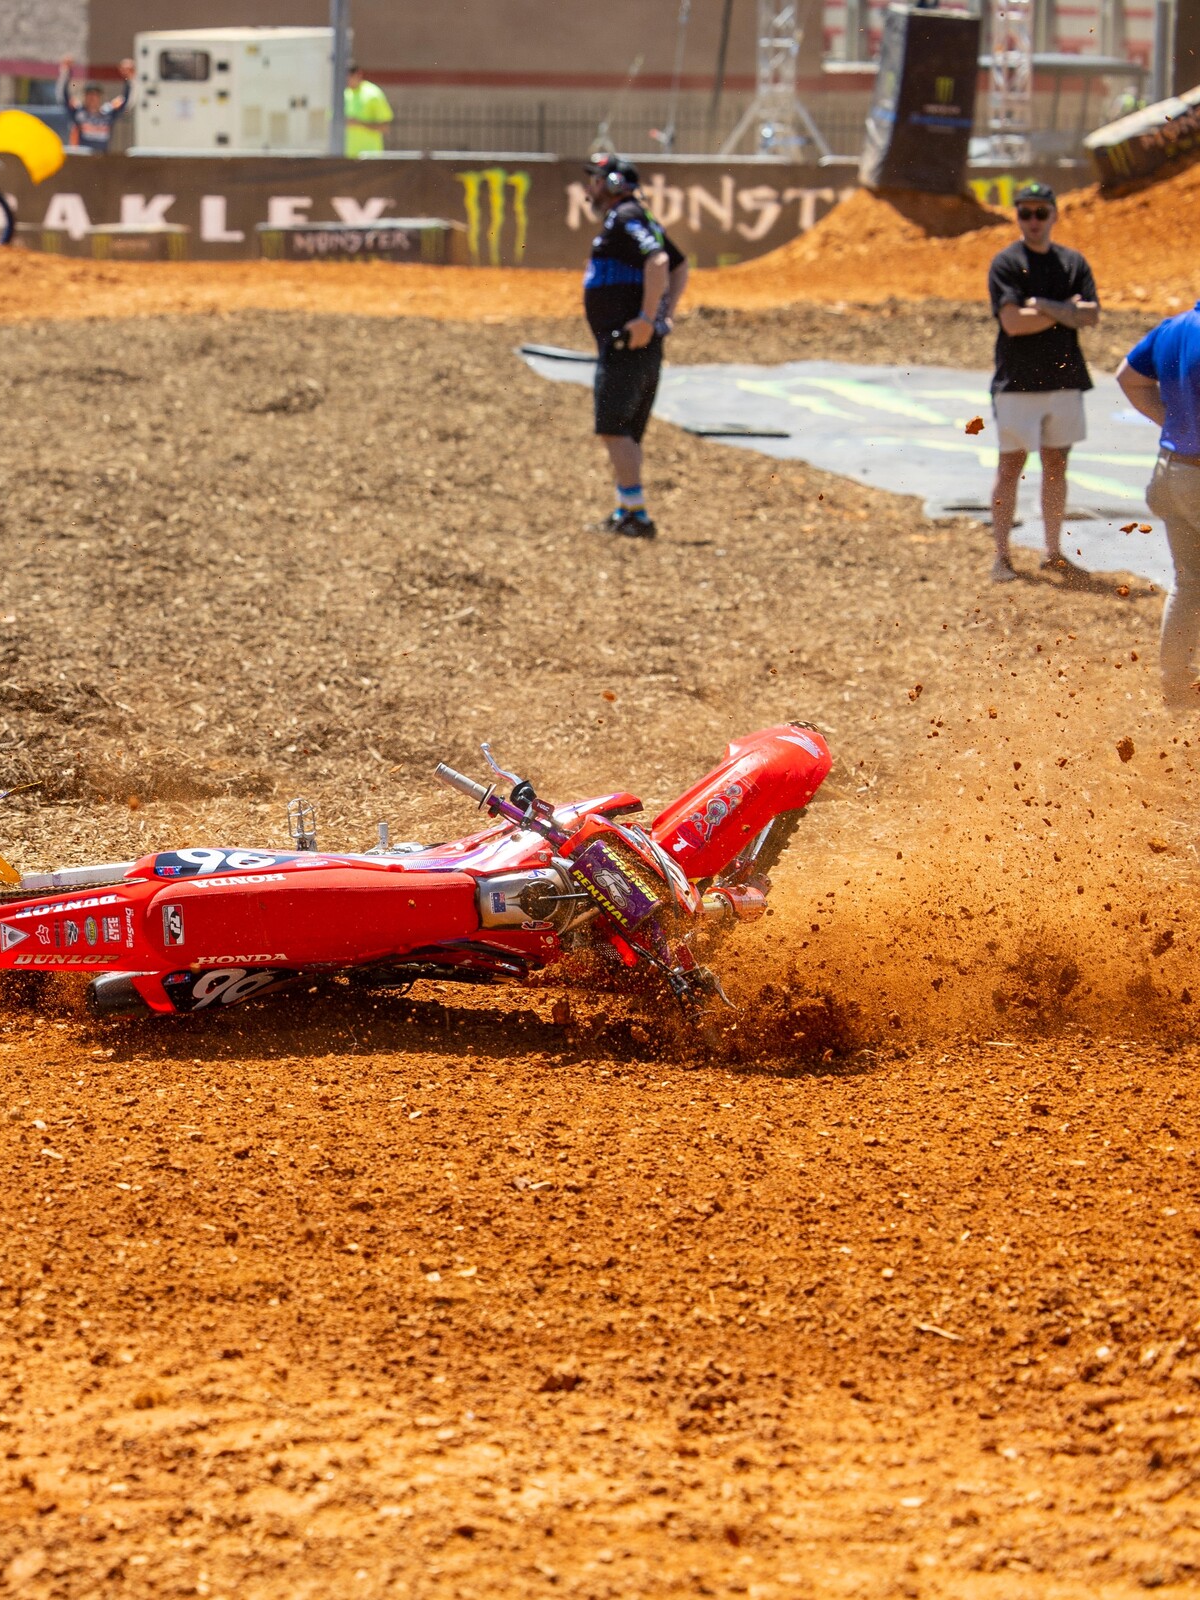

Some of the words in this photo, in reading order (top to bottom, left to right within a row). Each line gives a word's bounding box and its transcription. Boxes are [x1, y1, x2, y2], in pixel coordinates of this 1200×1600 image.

[176, 848, 276, 875] 96
[188, 873, 287, 889] HONDA
[15, 894, 118, 919] DUNLOP
[572, 869, 629, 927] RENTHAL
[14, 953, 119, 965] DUNLOP
[196, 953, 289, 965] HONDA
[191, 968, 284, 1011] 96
